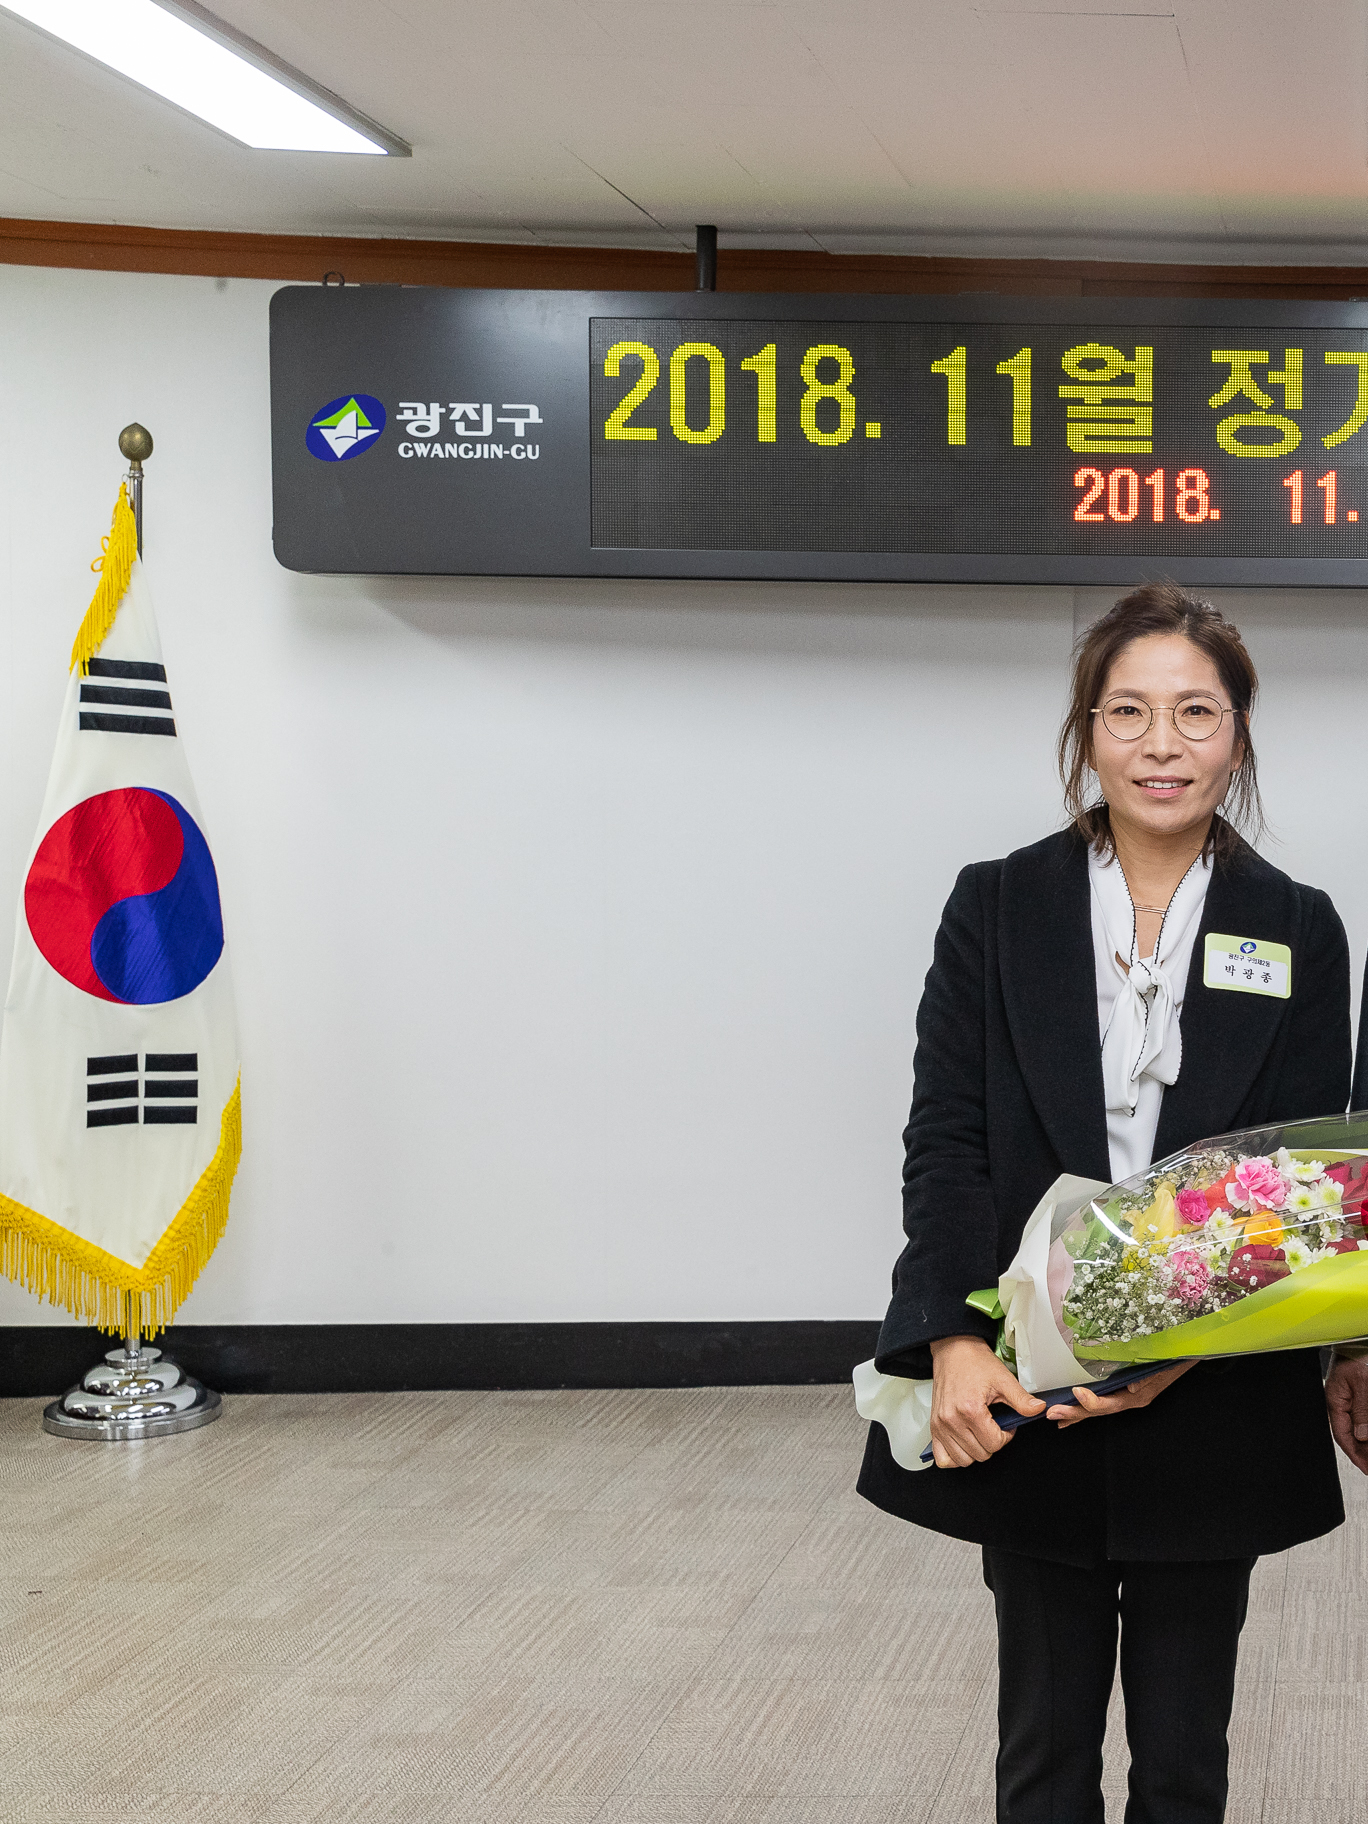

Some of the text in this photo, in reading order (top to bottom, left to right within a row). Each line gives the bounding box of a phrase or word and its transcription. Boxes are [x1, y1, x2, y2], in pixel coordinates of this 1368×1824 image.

[396, 402, 544, 438] 광진구
[603, 341, 882, 446] 2018.
[930, 342, 1154, 454] 11월
[397, 442, 541, 460] GWANGJIN-GU
[1073, 467, 1222, 524] 2018.
[1282, 470, 1360, 525] 11.
